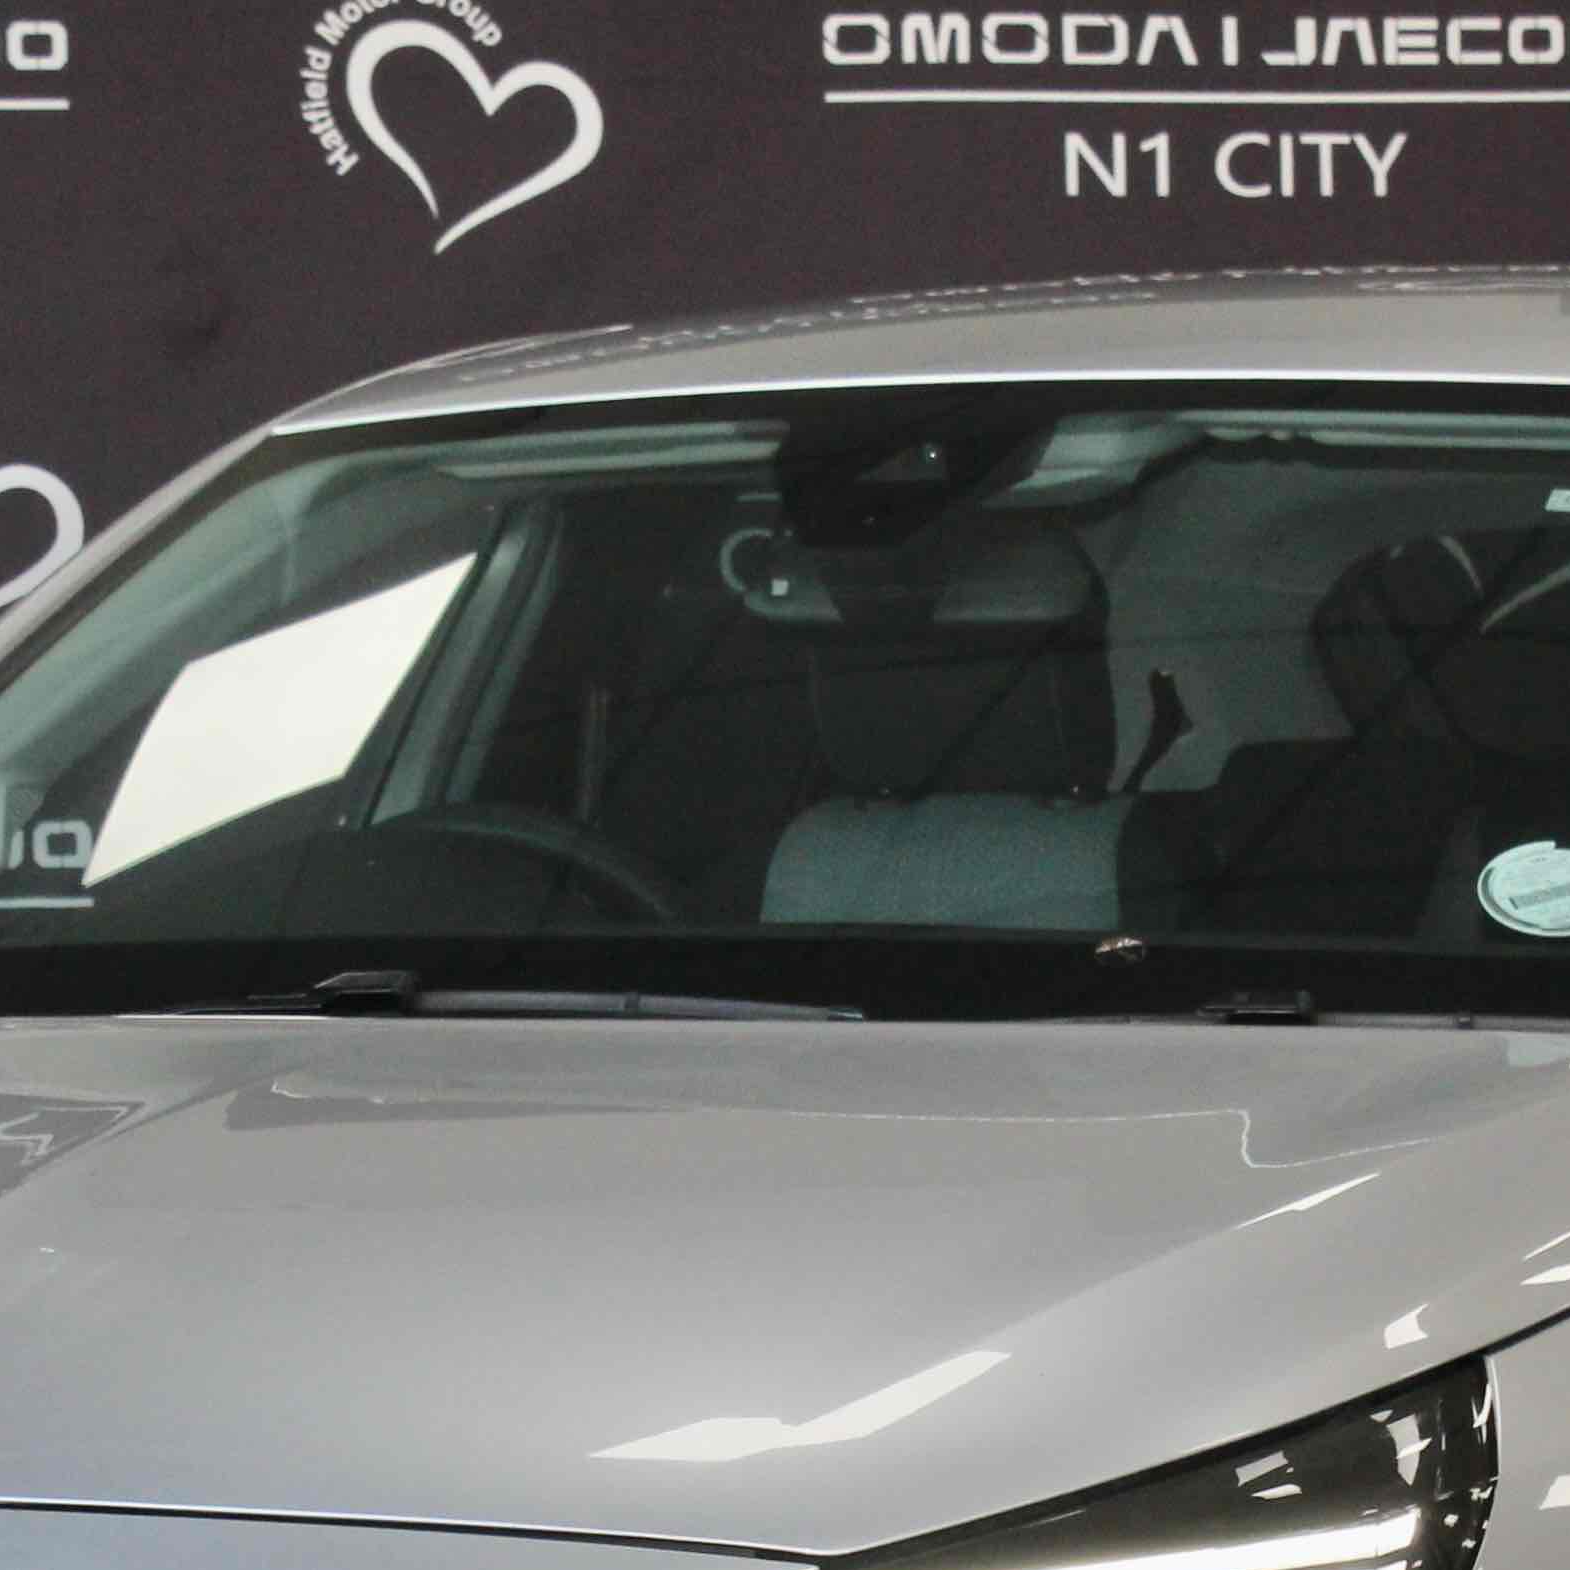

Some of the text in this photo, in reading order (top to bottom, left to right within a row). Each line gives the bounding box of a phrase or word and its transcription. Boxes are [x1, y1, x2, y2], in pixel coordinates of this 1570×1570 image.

[822, 12, 1198, 66] OMODA
[299, 0, 502, 176] Hatfield Mot oup
[1064, 132, 1407, 198] N1 CITY
